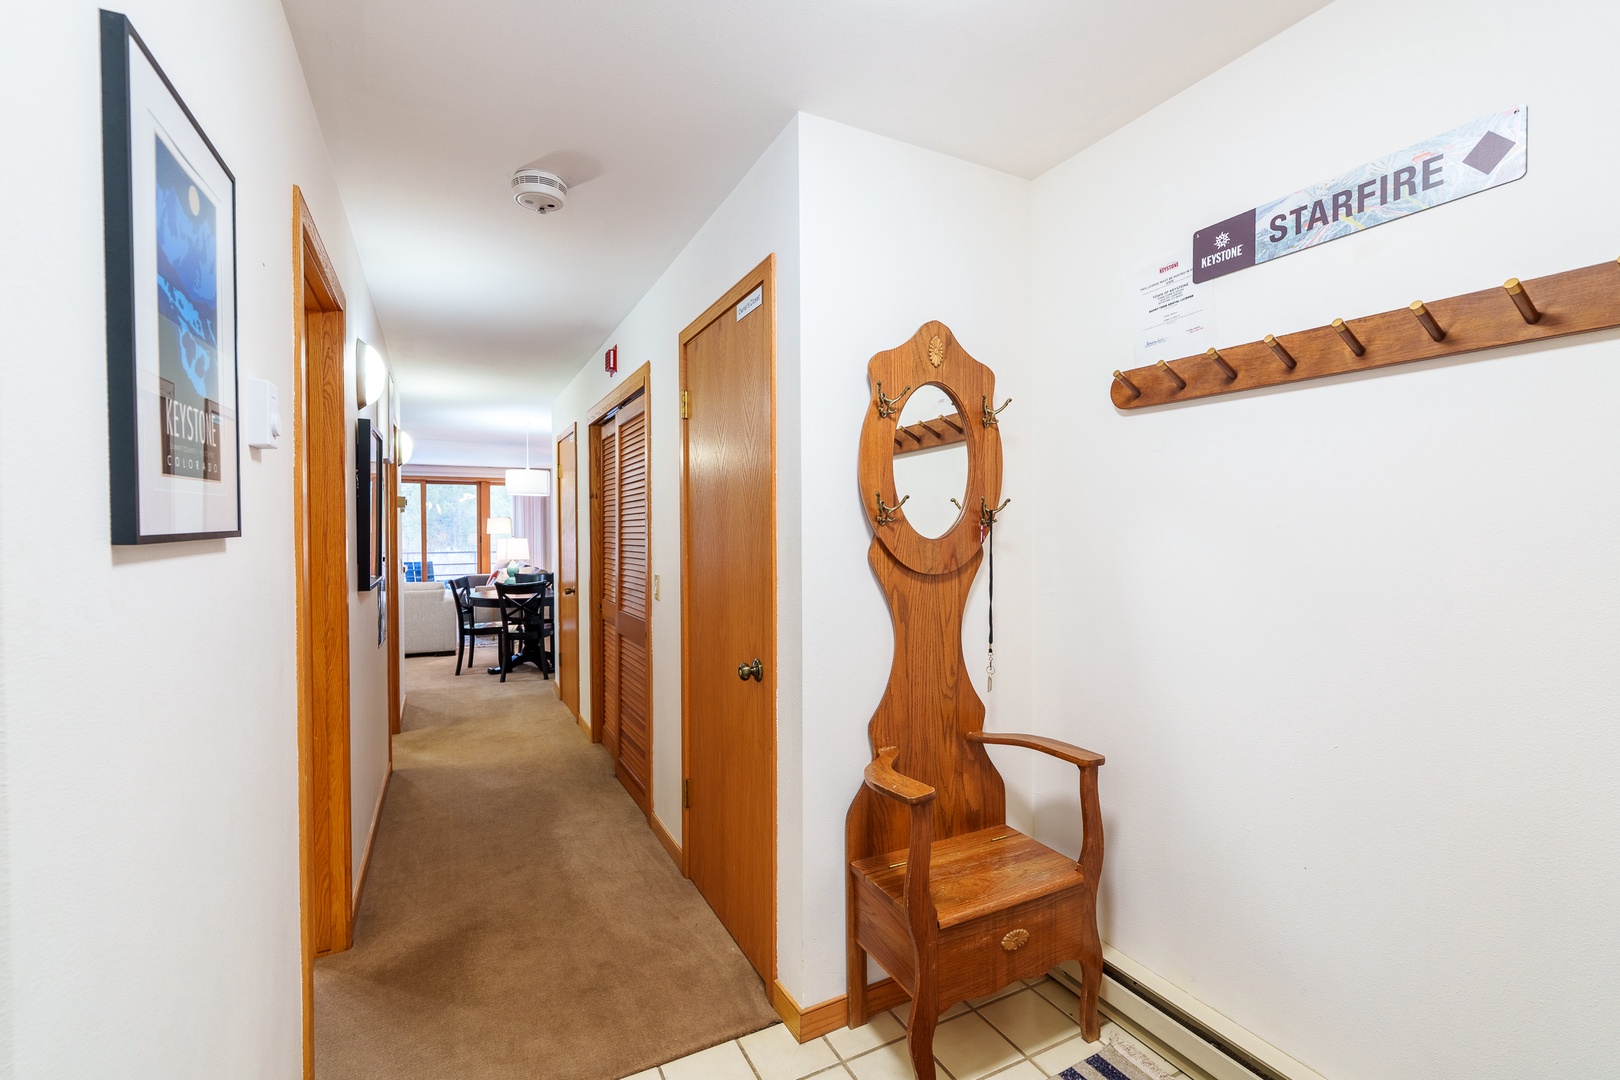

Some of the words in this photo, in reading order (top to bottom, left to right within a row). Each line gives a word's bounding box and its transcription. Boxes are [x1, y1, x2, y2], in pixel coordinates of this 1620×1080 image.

[1269, 154, 1444, 243] STARFIRE
[1159, 261, 1179, 274] KEYSTONE
[1201, 244, 1243, 269] KEYSTONE
[1169, 283, 1189, 293] KEYSTONE
[166, 397, 217, 447] KEYSTONE
[167, 455, 218, 474] COLORADO
